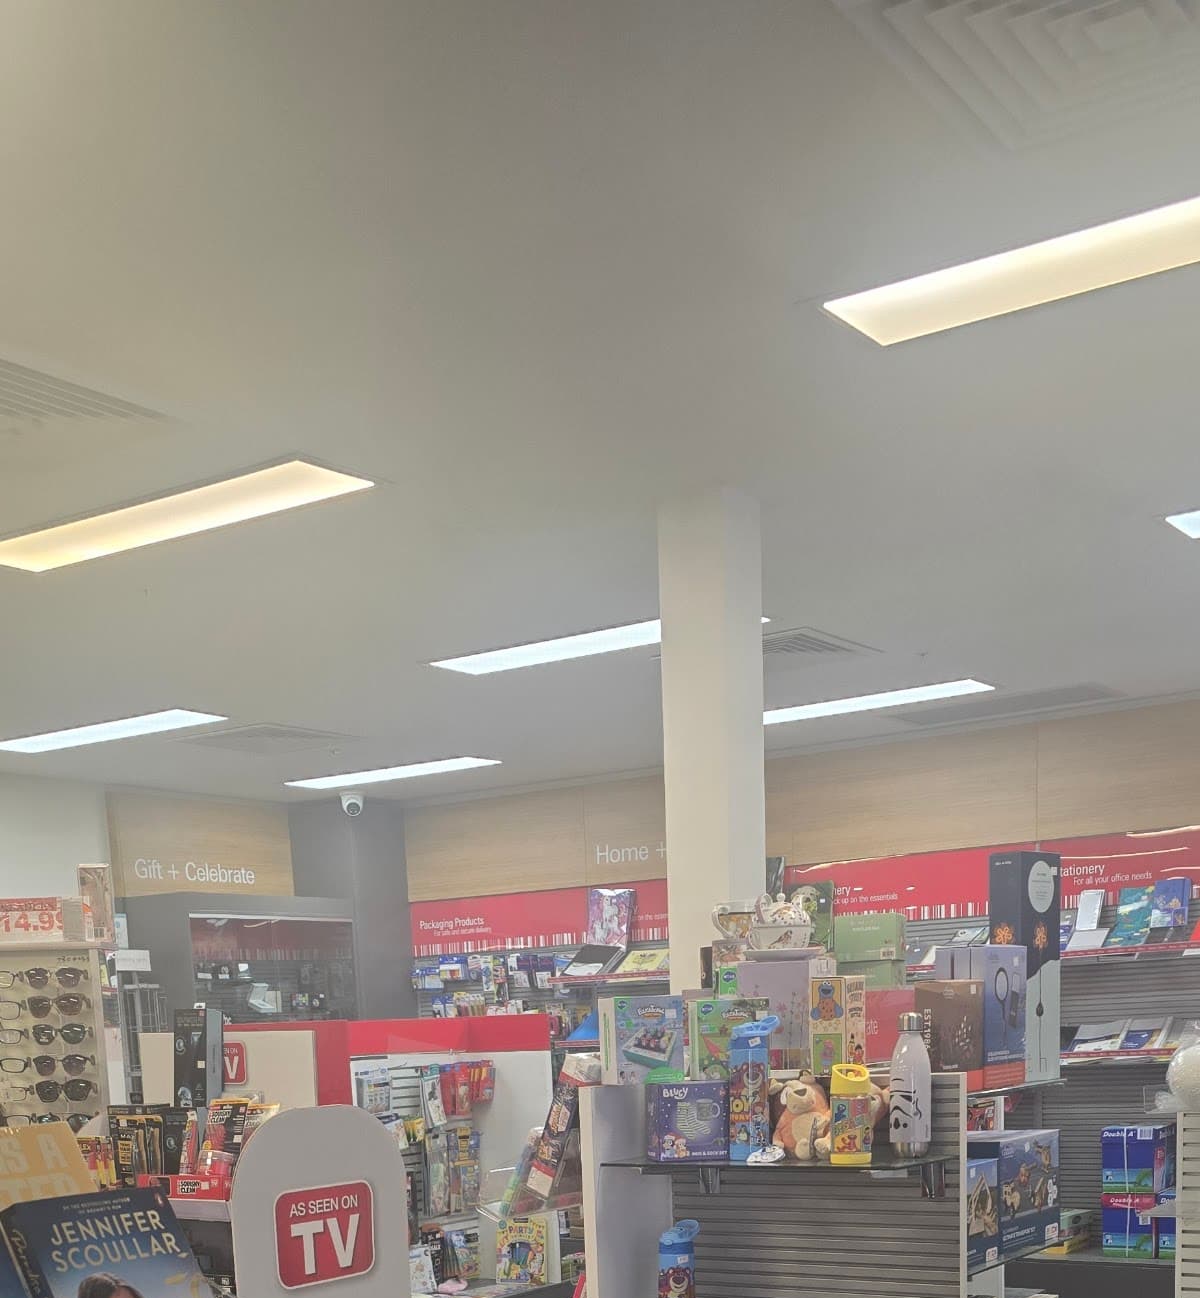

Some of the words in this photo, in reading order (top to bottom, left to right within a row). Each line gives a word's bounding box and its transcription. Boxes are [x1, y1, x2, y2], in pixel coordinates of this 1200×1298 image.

[596, 845, 649, 865] Home
[134, 858, 164, 881] Gift
[168, 865, 180, 880] +
[185, 862, 256, 885] Celebrate
[1060, 864, 1105, 877] tationery
[1073, 878, 1083, 886] For
[1085, 876, 1093, 885] all
[1095, 875, 1109, 885] your
[1110, 873, 1130, 882] office
[1131, 872, 1152, 881] needs
[834, 885, 851, 897] nery
[859, 895, 869, 903] the
[420, 919, 454, 930] Packaging
[454, 917, 484, 926] Products
[289, 1203, 306, 1218] AS
[308, 1197, 339, 1214] SEEN
[341, 1194, 358, 1209] ON
[51, 1210, 165, 1246] JENNIFER
[51, 1232, 180, 1273] SCOULLAR
[290, 1213, 360, 1275] TV
